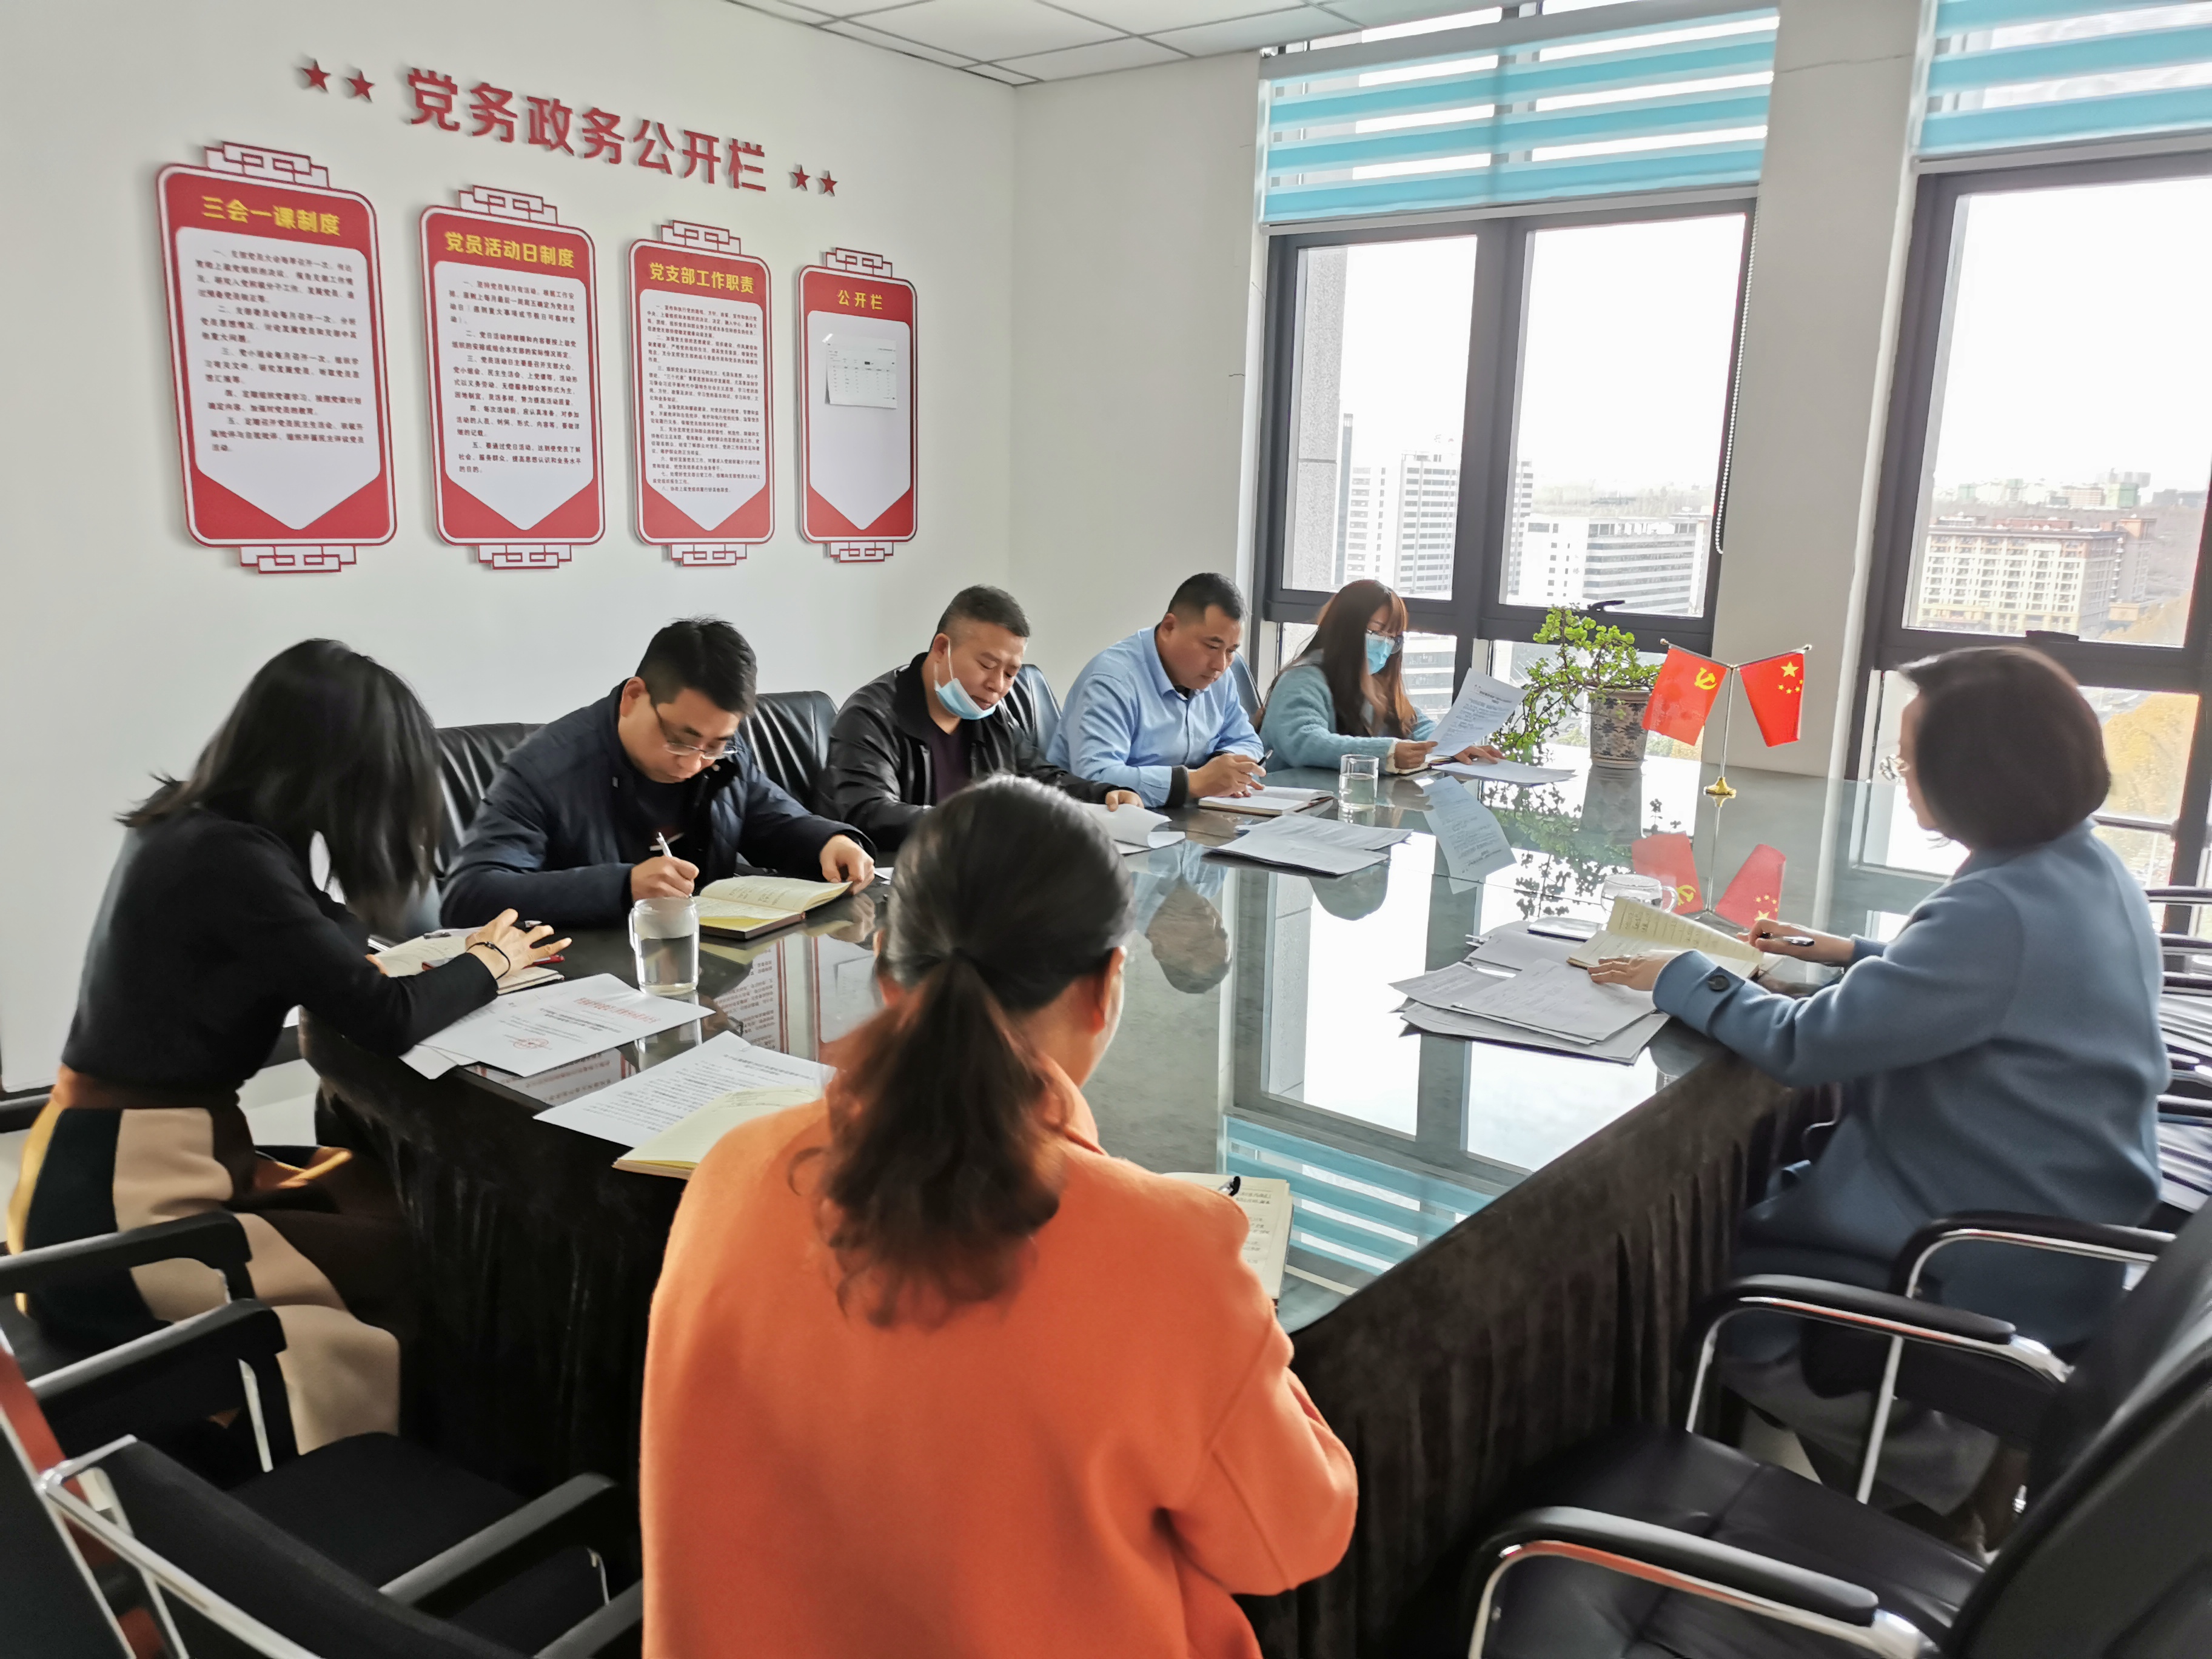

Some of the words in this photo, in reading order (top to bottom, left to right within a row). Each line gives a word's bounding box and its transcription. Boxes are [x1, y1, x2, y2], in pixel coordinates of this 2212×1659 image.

[407, 67, 767, 192] 党务政务公开栏
[202, 195, 341, 237] 三会一课制度
[444, 230, 575, 269] 党员活动日制度
[649, 262, 754, 294] 党支部工作职责
[837, 289, 883, 310] 公开栏
